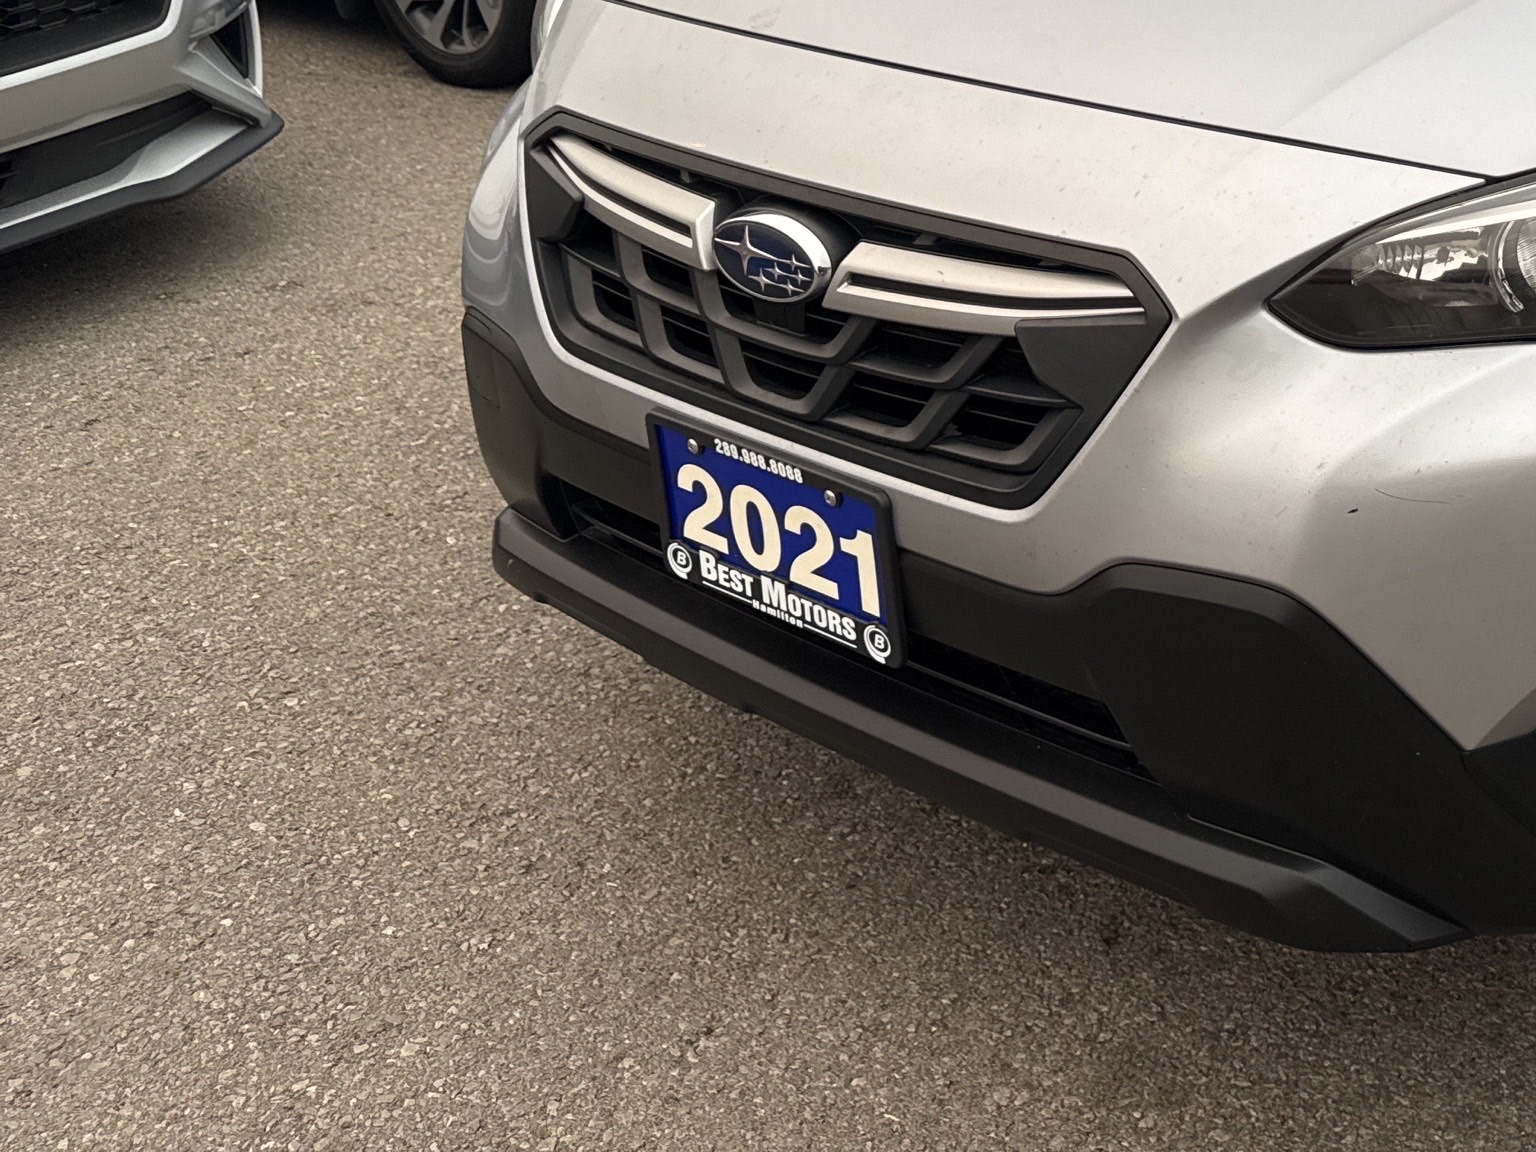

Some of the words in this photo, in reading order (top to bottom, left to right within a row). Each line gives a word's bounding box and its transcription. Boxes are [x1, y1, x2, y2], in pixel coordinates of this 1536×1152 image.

[713, 438, 803, 484] 289.988.8088
[677, 463, 880, 618] 2021
[752, 599, 804, 629] Hamilton
